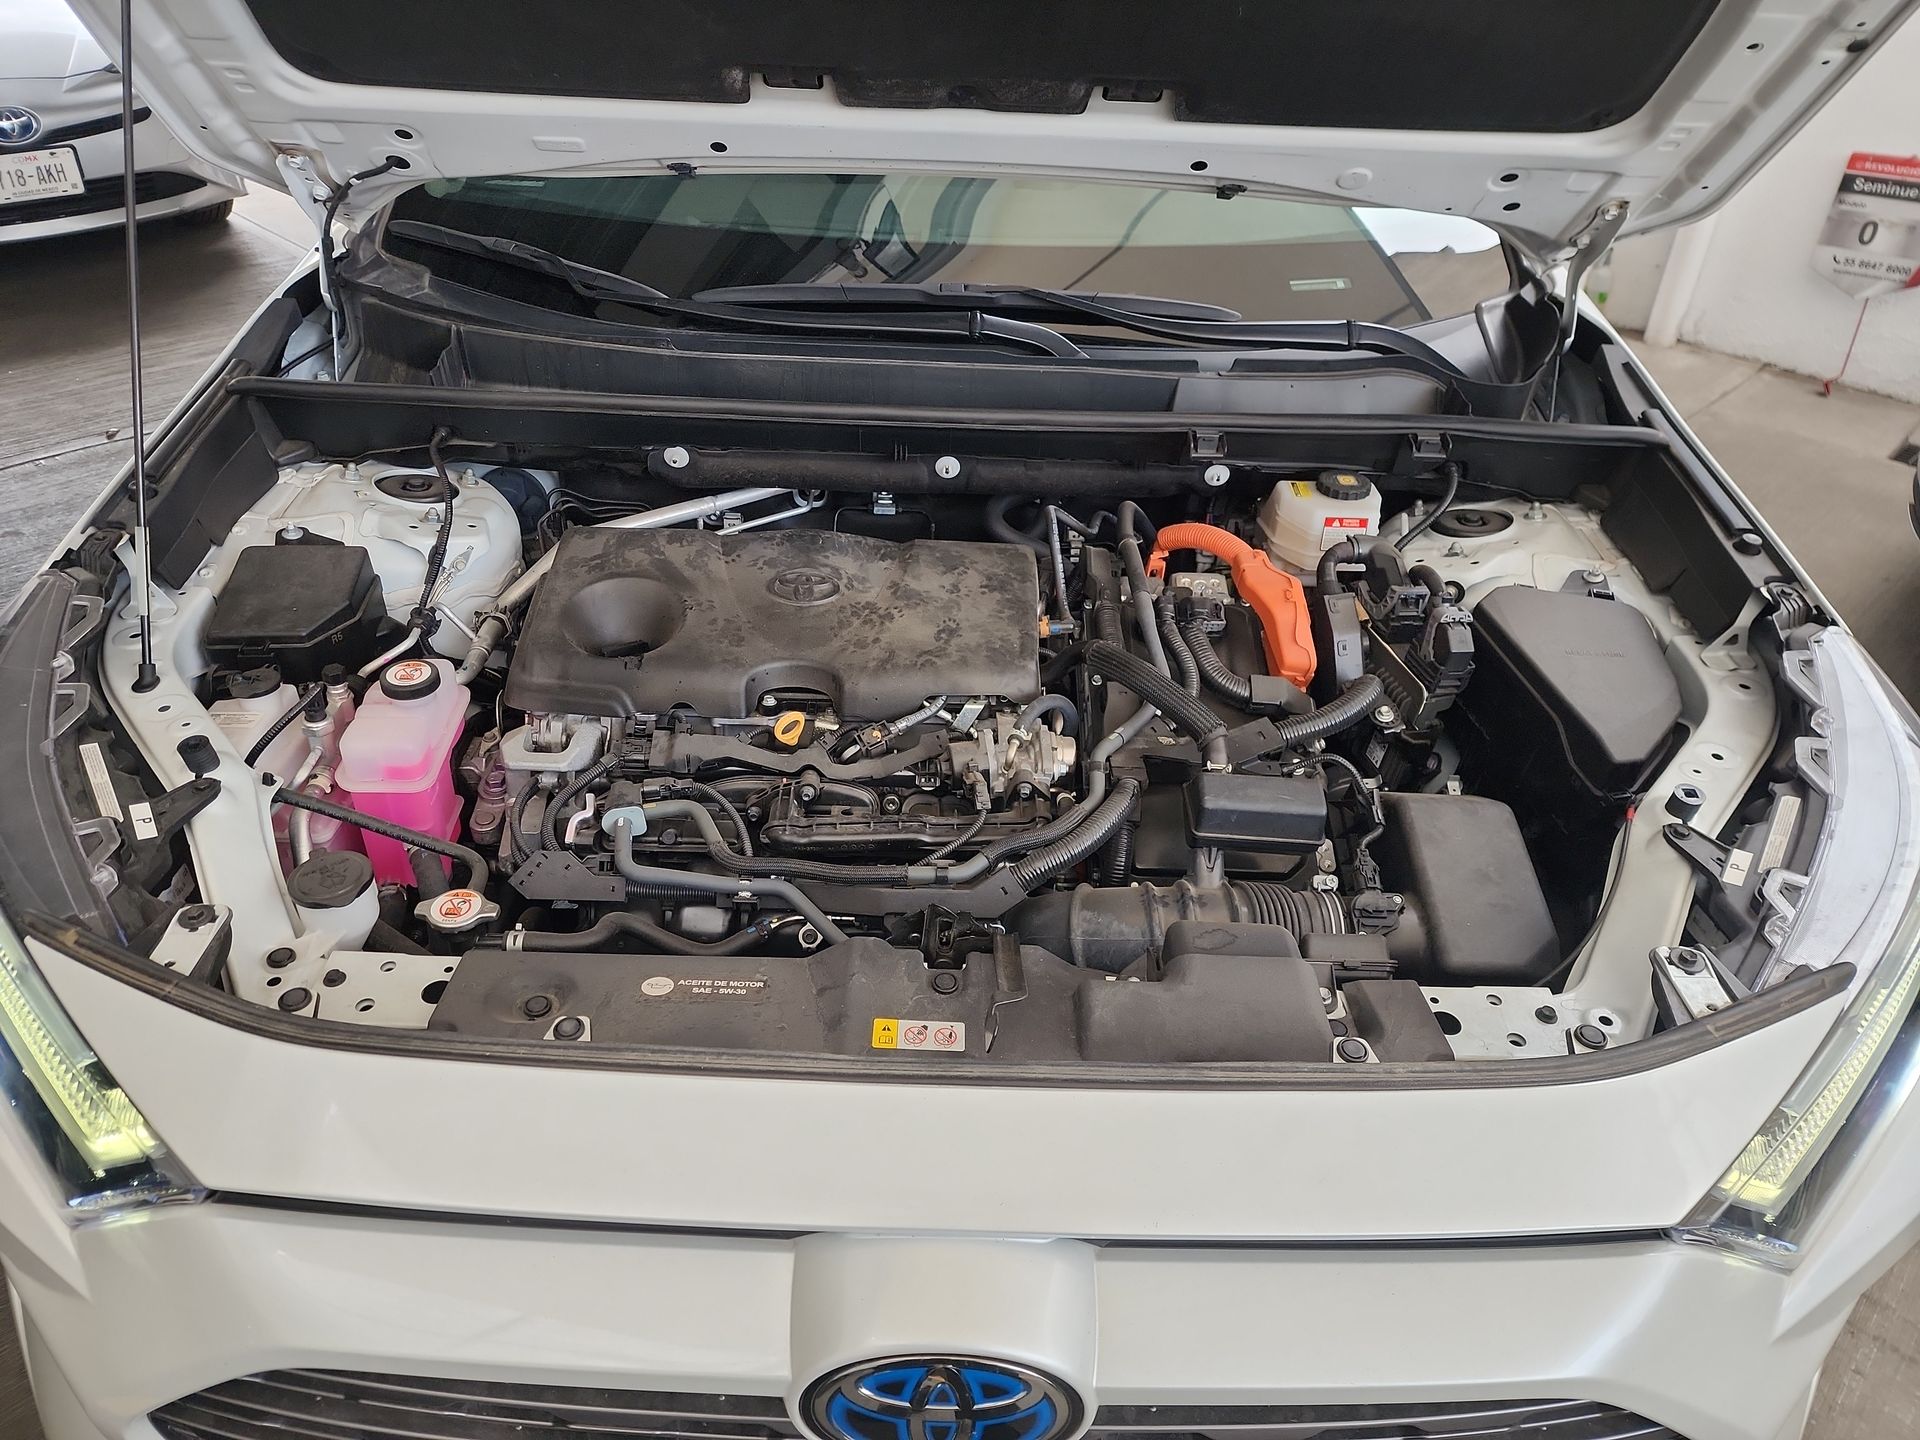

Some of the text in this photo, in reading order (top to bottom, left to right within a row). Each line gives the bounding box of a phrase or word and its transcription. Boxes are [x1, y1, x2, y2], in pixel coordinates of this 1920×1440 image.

[0, 163, 67, 190] 18-AKH
[1853, 177, 1920, 198] Seminue
[1859, 221, 1878, 245] 0
[729, 980, 765, 988] MOTOR
